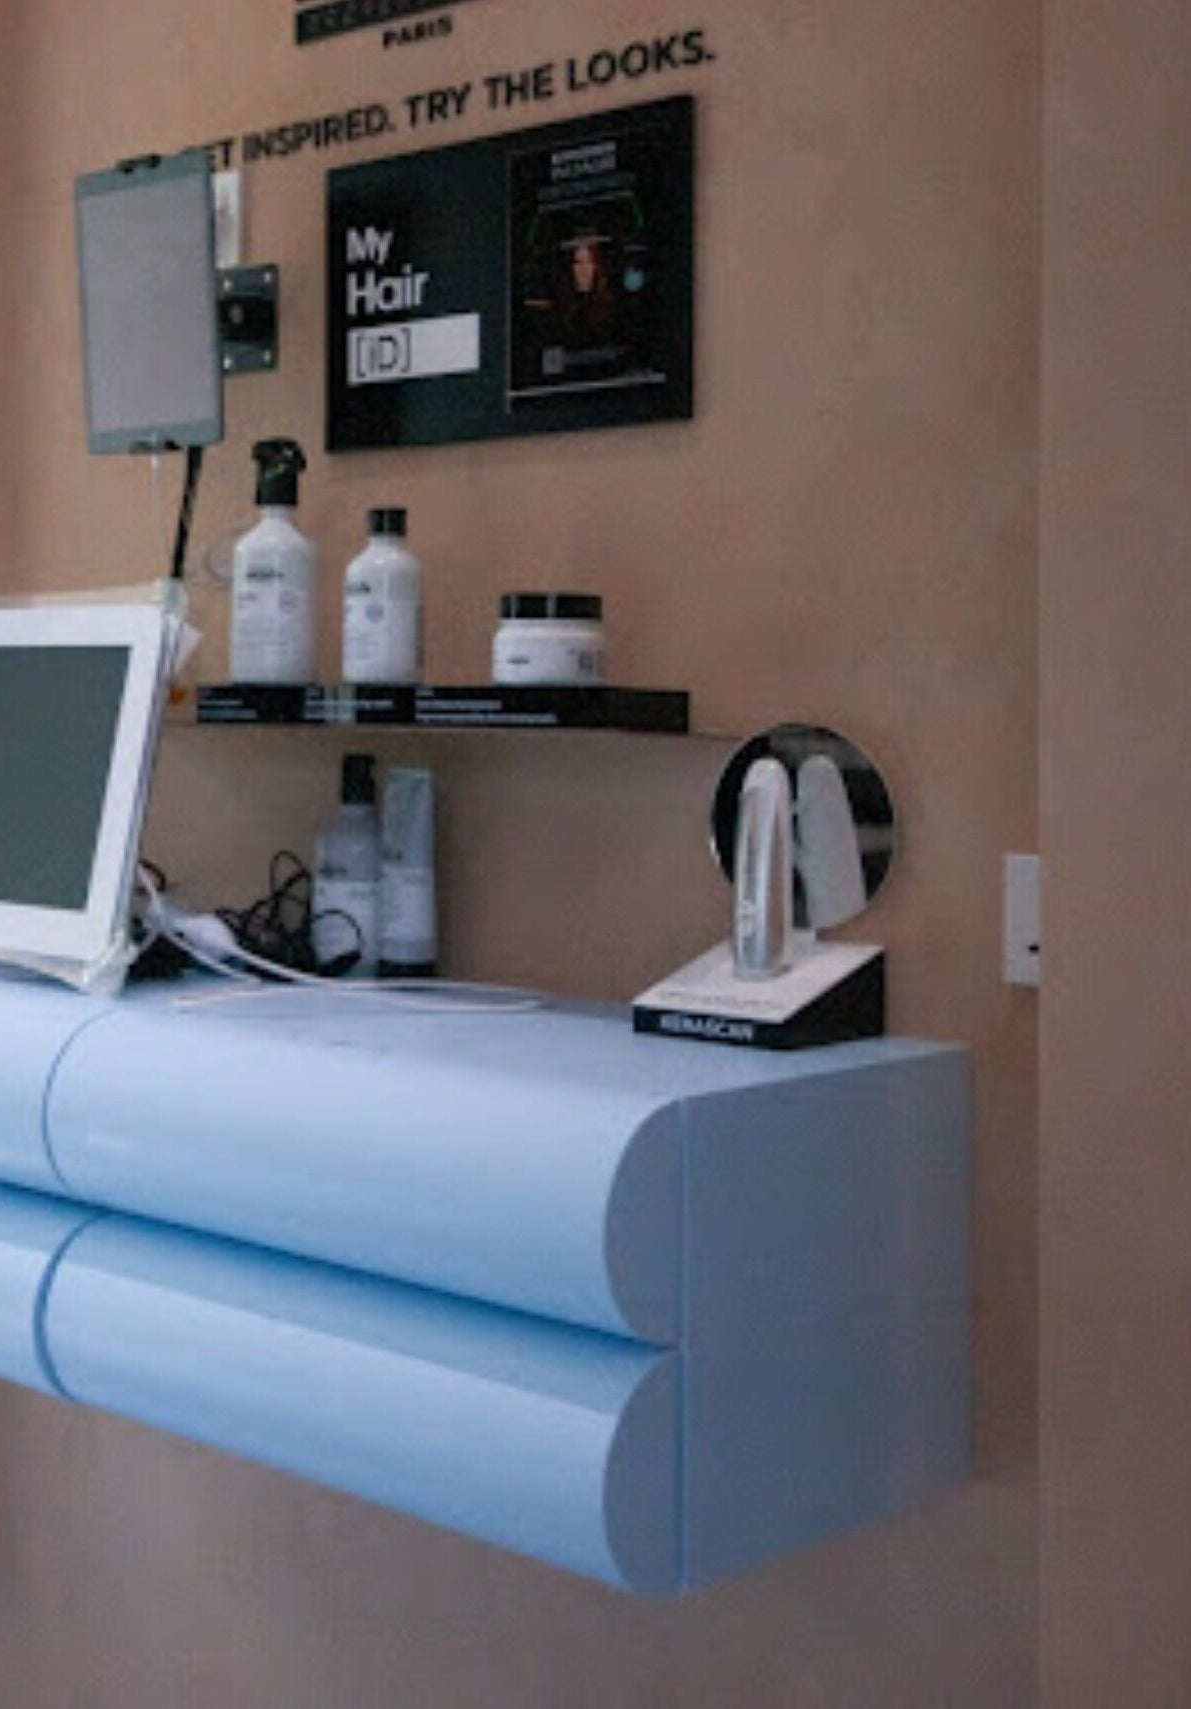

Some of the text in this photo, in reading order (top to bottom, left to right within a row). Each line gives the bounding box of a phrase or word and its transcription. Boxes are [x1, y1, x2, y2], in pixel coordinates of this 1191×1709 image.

[383, 14, 453, 49] PARIS
[243, 103, 396, 163] INSPIRED.
[404, 81, 471, 128] TRY
[483, 62, 554, 108] THE
[566, 29, 717, 91] LOOKS.
[347, 226, 394, 266] My
[346, 263, 430, 316] Hair
